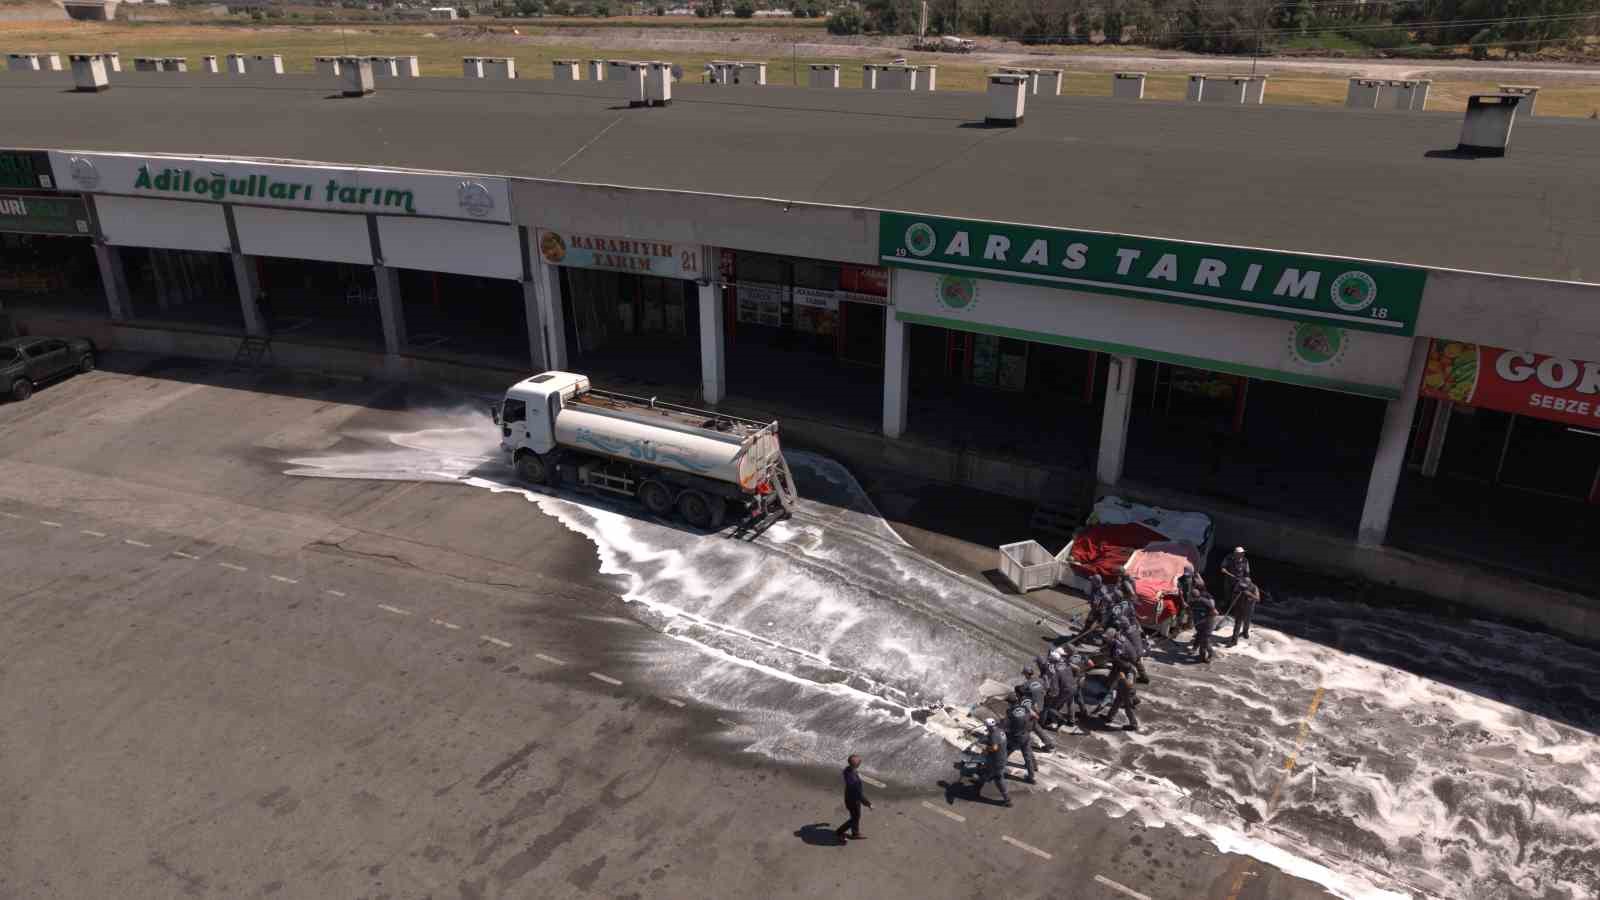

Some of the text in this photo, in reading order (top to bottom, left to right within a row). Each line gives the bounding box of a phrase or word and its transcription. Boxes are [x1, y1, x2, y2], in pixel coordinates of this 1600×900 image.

[134, 164, 313, 201] Adiloğulları
[325, 178, 416, 213] tarım
[592, 252, 653, 271] TARIM
[680, 250, 697, 272] 21
[895, 247, 907, 258] 19
[944, 230, 1090, 271] ARAS
[1115, 247, 1322, 301] TARIM
[1369, 306, 1388, 319] 18
[1529, 393, 1589, 414] SEBZE
